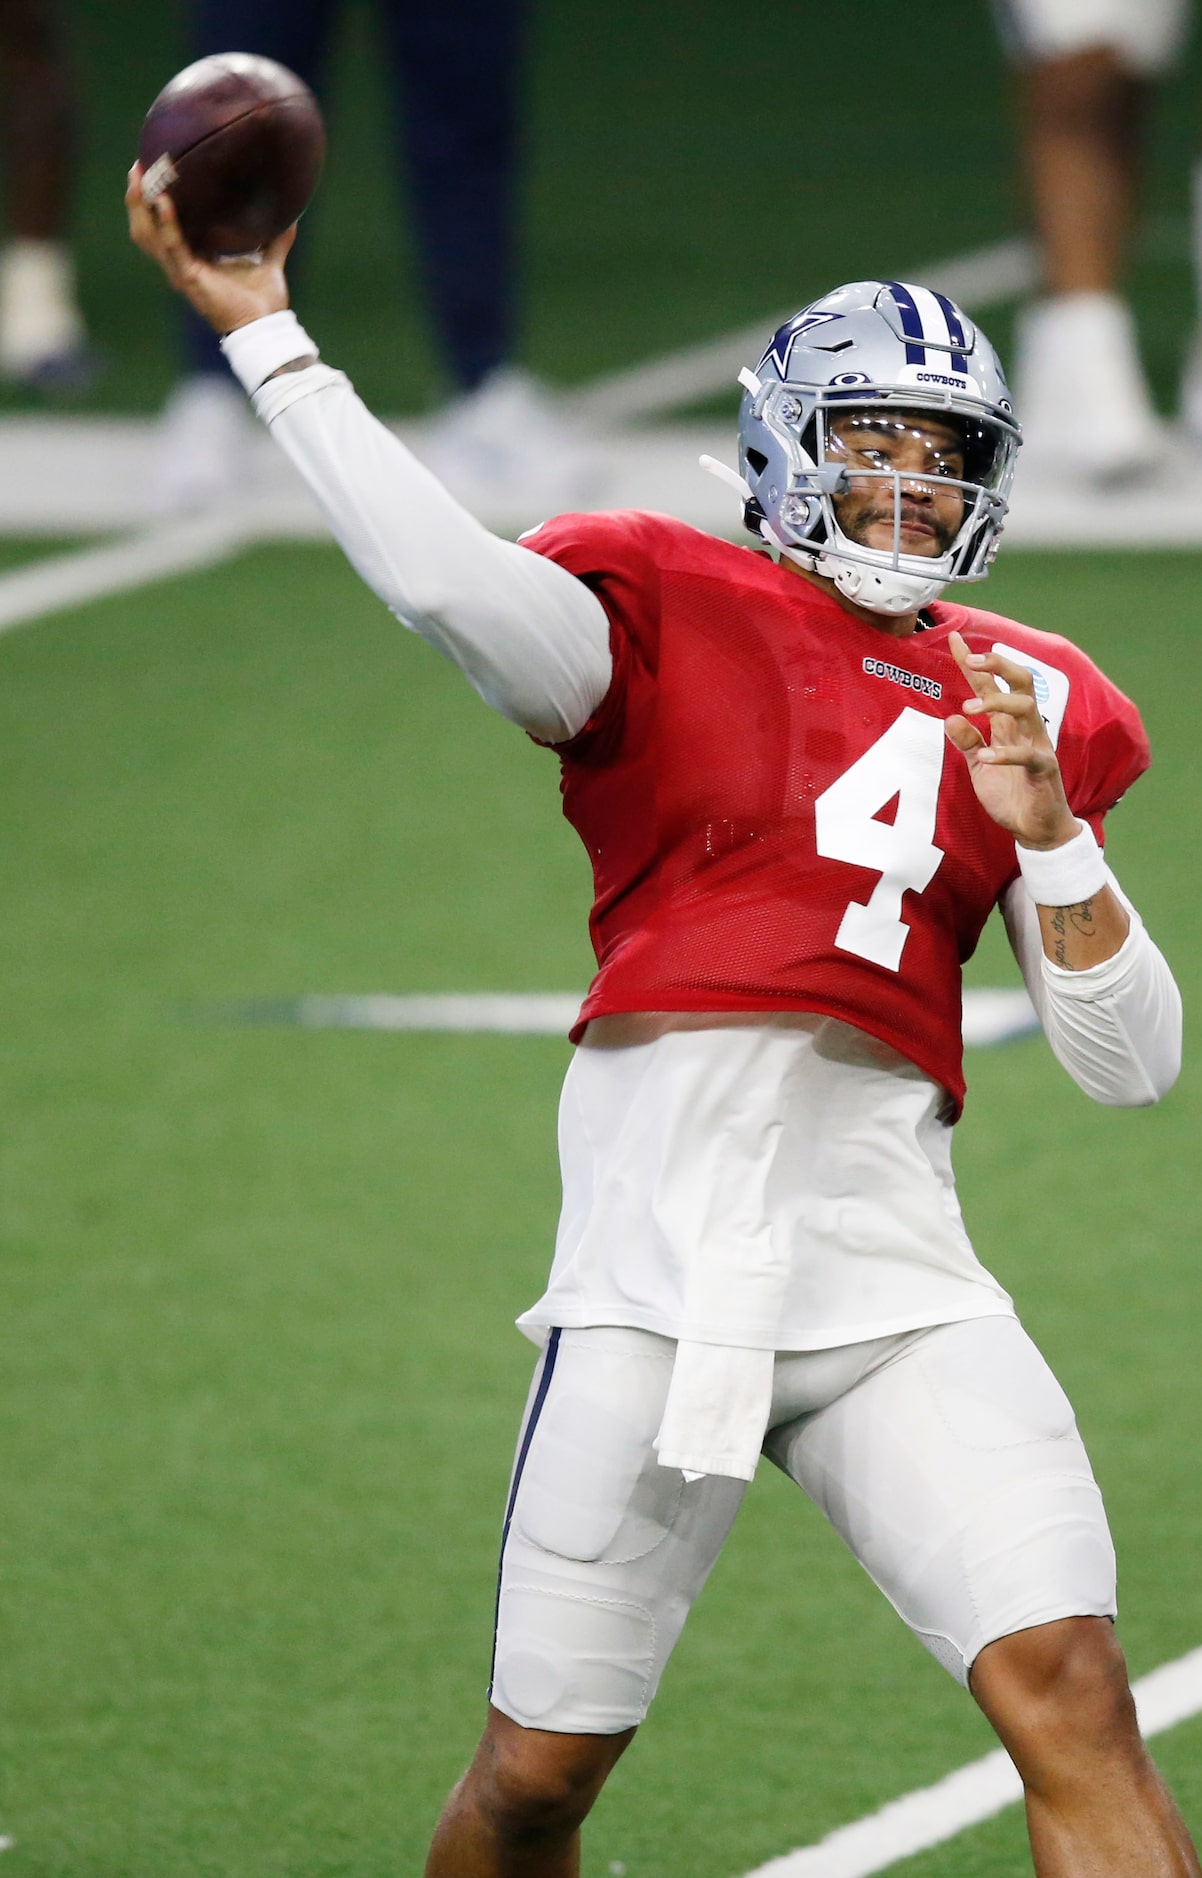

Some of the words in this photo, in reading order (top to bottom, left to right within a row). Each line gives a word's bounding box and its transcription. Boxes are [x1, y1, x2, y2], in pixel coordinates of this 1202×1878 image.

[916, 373, 967, 390] COWBOYS
[862, 656, 943, 700] COWBOYS
[814, 705, 946, 974] 4
